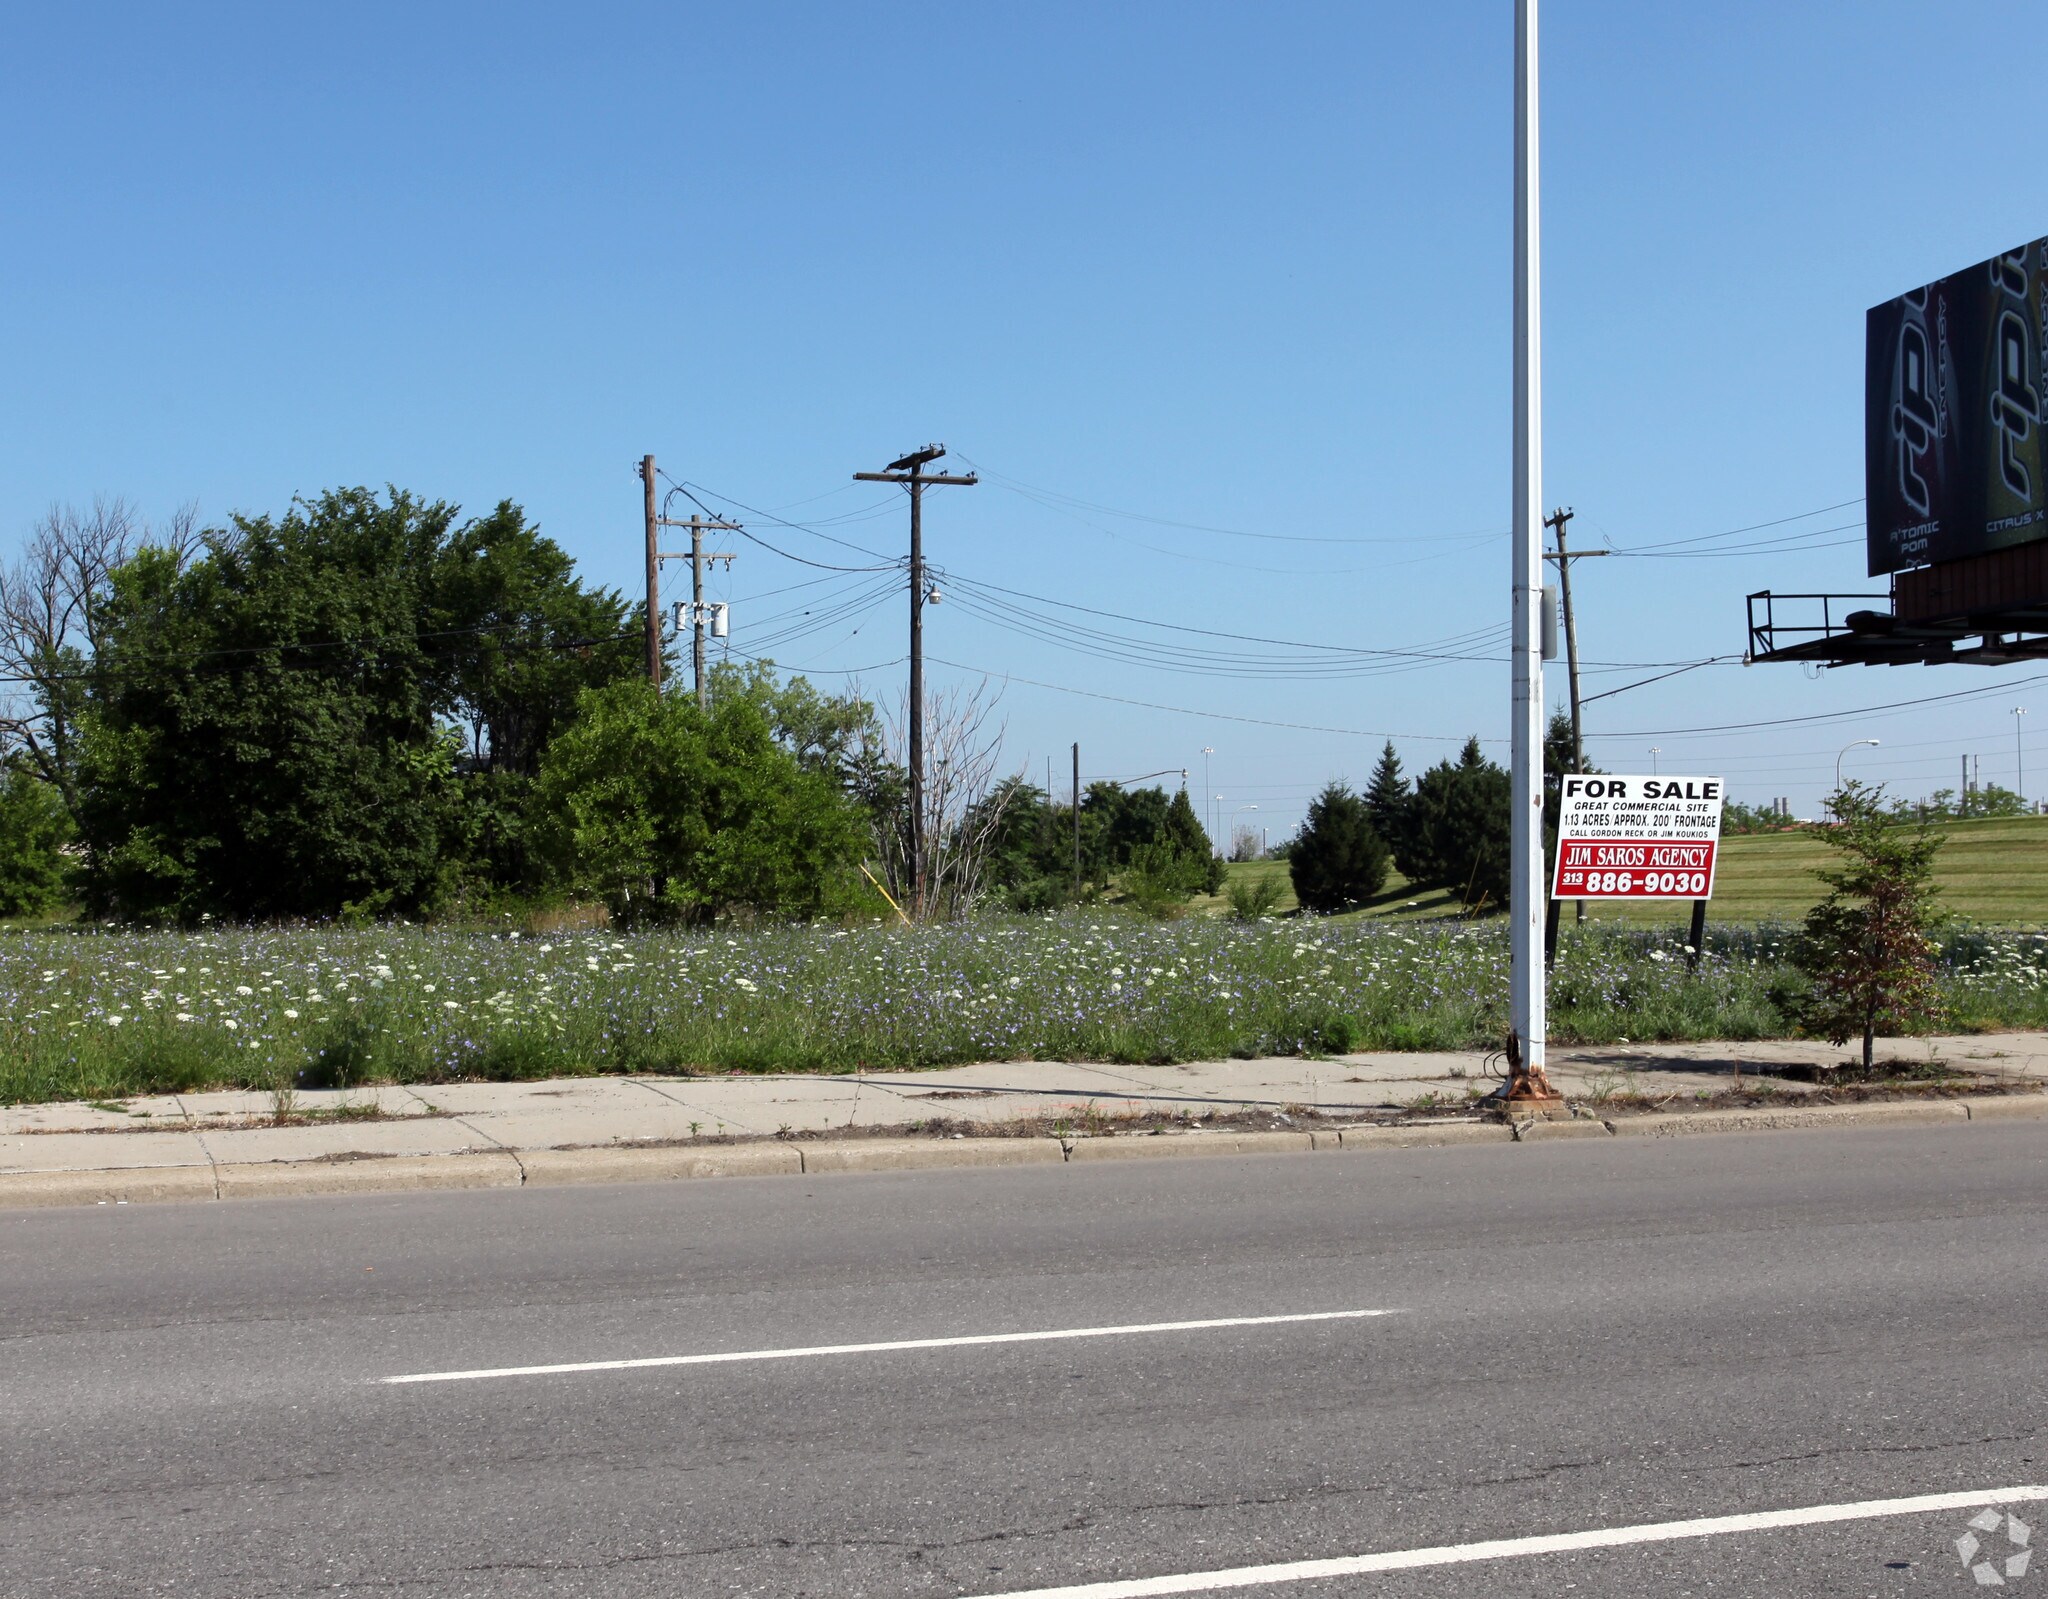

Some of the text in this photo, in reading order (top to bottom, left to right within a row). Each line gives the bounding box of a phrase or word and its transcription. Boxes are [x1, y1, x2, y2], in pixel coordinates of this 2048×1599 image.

[1986, 510, 2044, 533] CITRUS X
[1901, 538, 1928, 554] POM
[1567, 780, 1719, 799] FOR SALE
[1574, 802, 1709, 812] GREAT COMMERCIAL SITE
[1565, 813, 1578, 826] 1.13
[1653, 816, 1672, 827] 200'
[1675, 816, 1716, 827] FRONTAGE
[1566, 848, 1708, 866] JIM SAROS AGENCY
[1563, 872, 1705, 893] 313 886-9030
